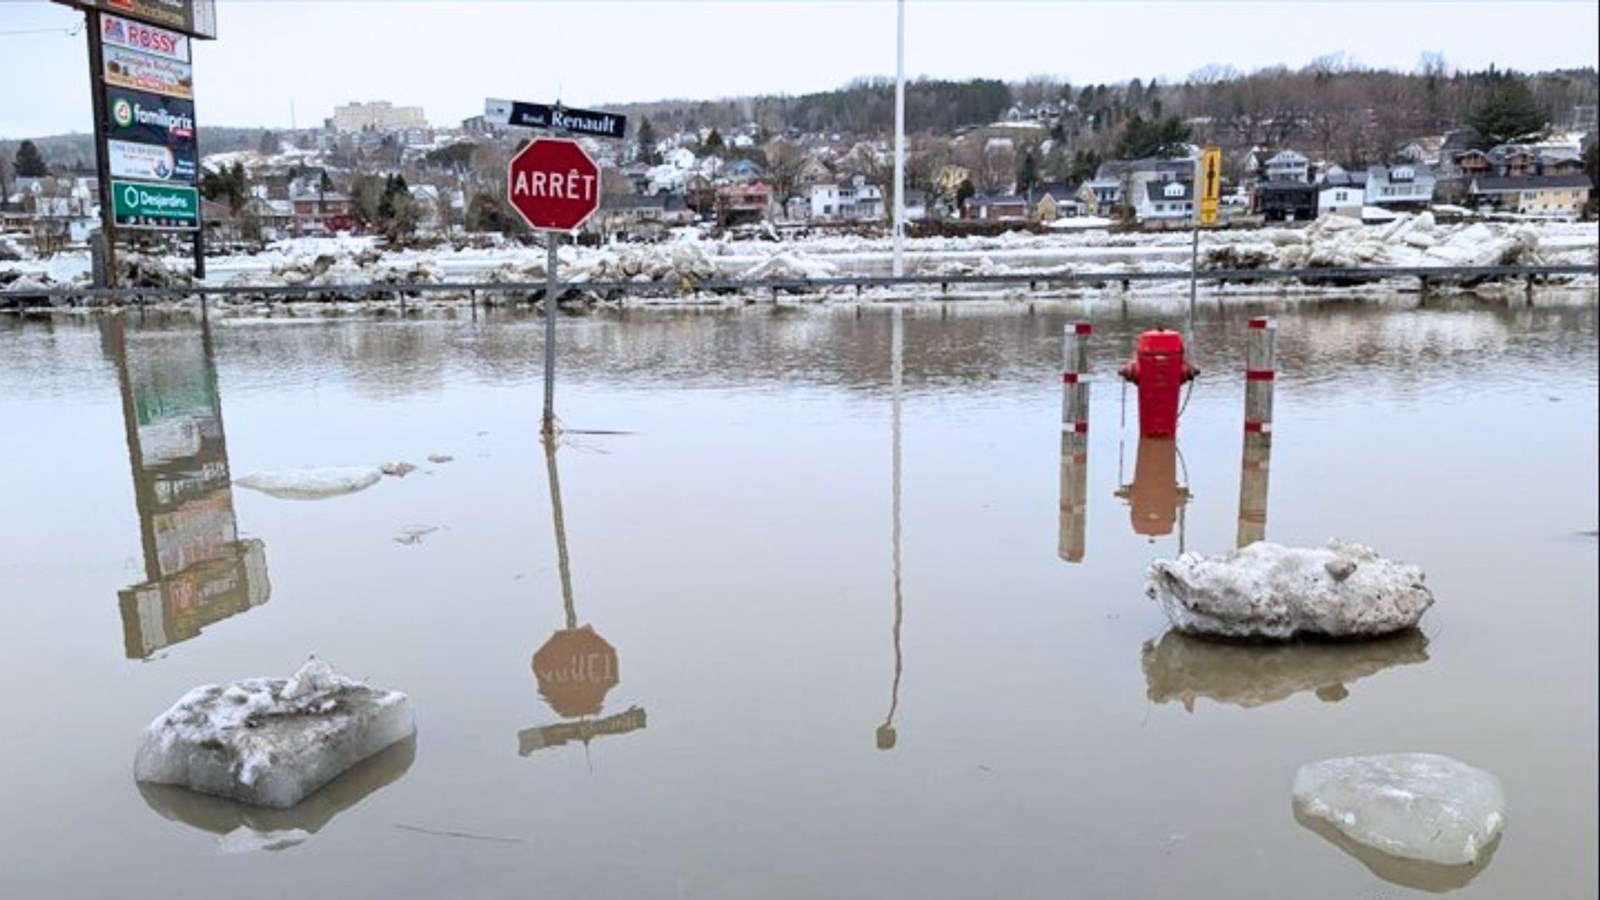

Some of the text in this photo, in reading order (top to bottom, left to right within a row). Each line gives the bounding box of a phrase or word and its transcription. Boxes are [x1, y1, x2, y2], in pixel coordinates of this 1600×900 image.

[128, 25, 178, 55] ROSSY
[134, 104, 193, 131] familiprix
[551, 111, 616, 133] Renault
[514, 168, 596, 201] ARRÊT
[140, 190, 188, 209] Desjardins
